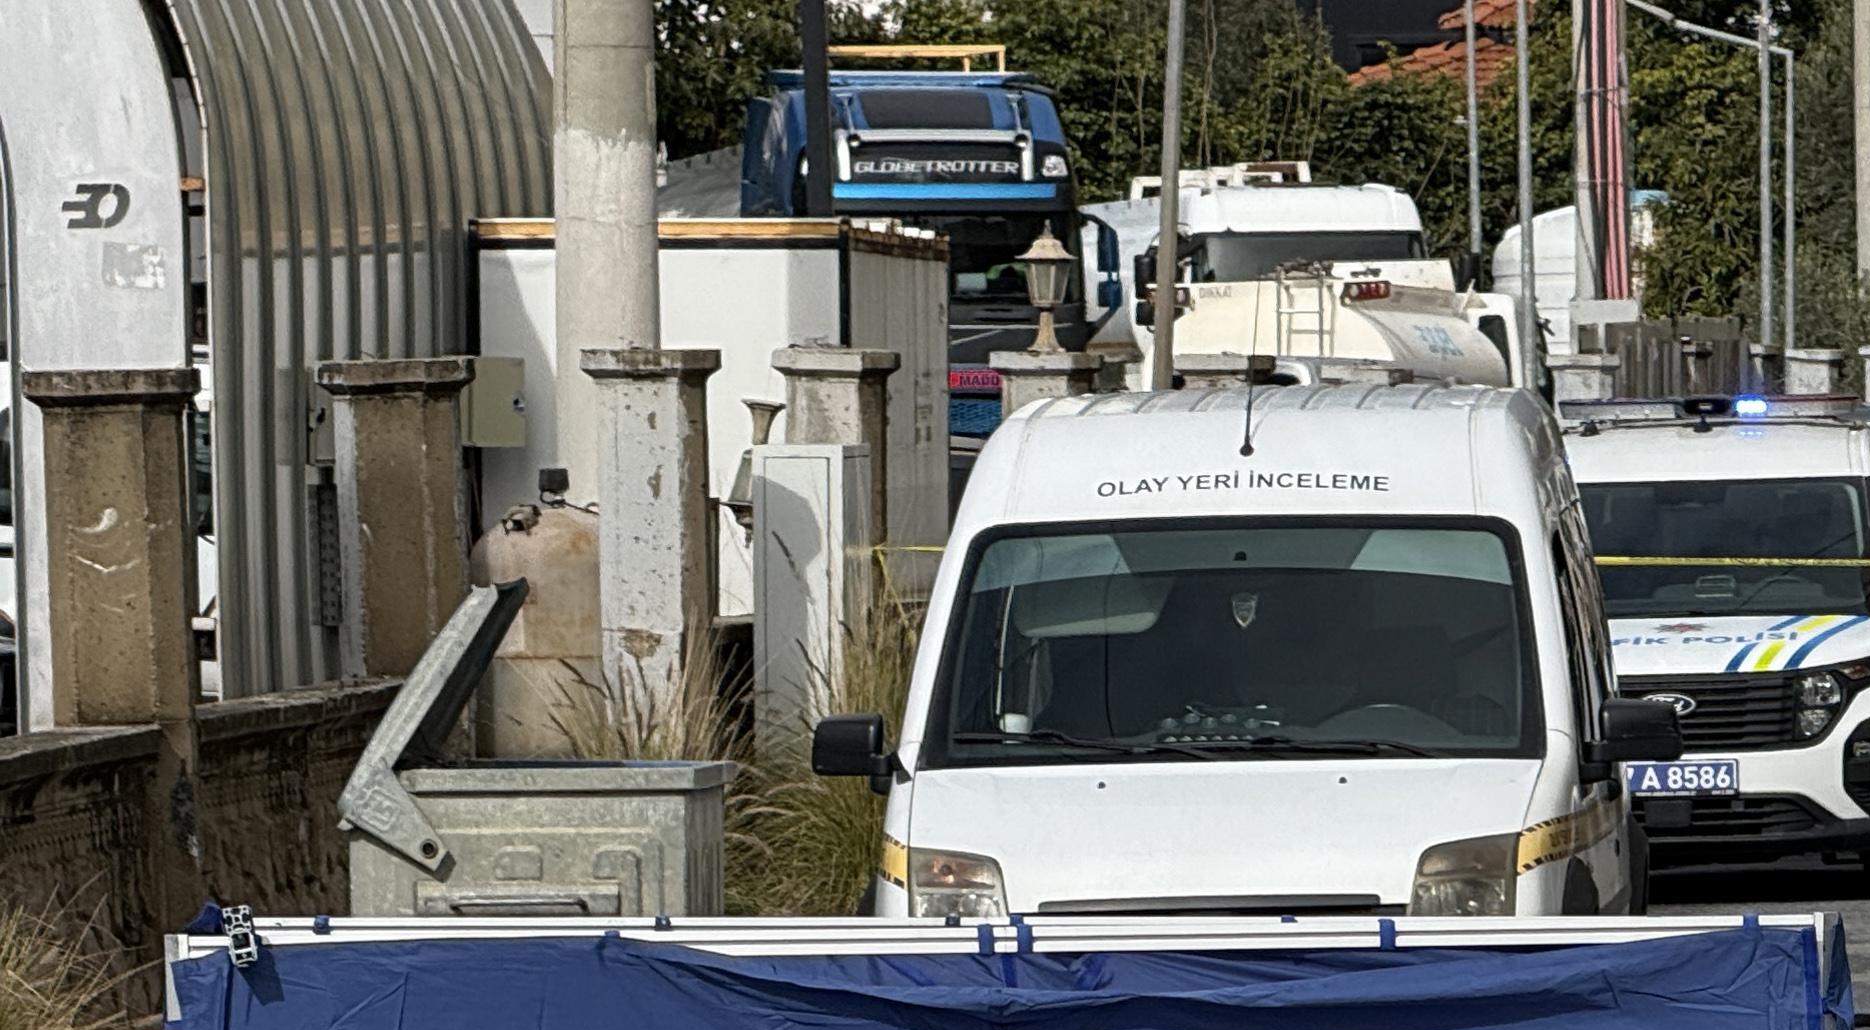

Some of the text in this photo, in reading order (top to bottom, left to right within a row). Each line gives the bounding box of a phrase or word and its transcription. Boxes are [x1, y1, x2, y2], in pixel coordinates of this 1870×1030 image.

[854, 159, 1020, 175] GLOBETROTTER
[1097, 470, 1390, 497] OLAY YERİ İNCELEME
[1641, 767, 1662, 790] A
[1667, 765, 1731, 789] 8586
